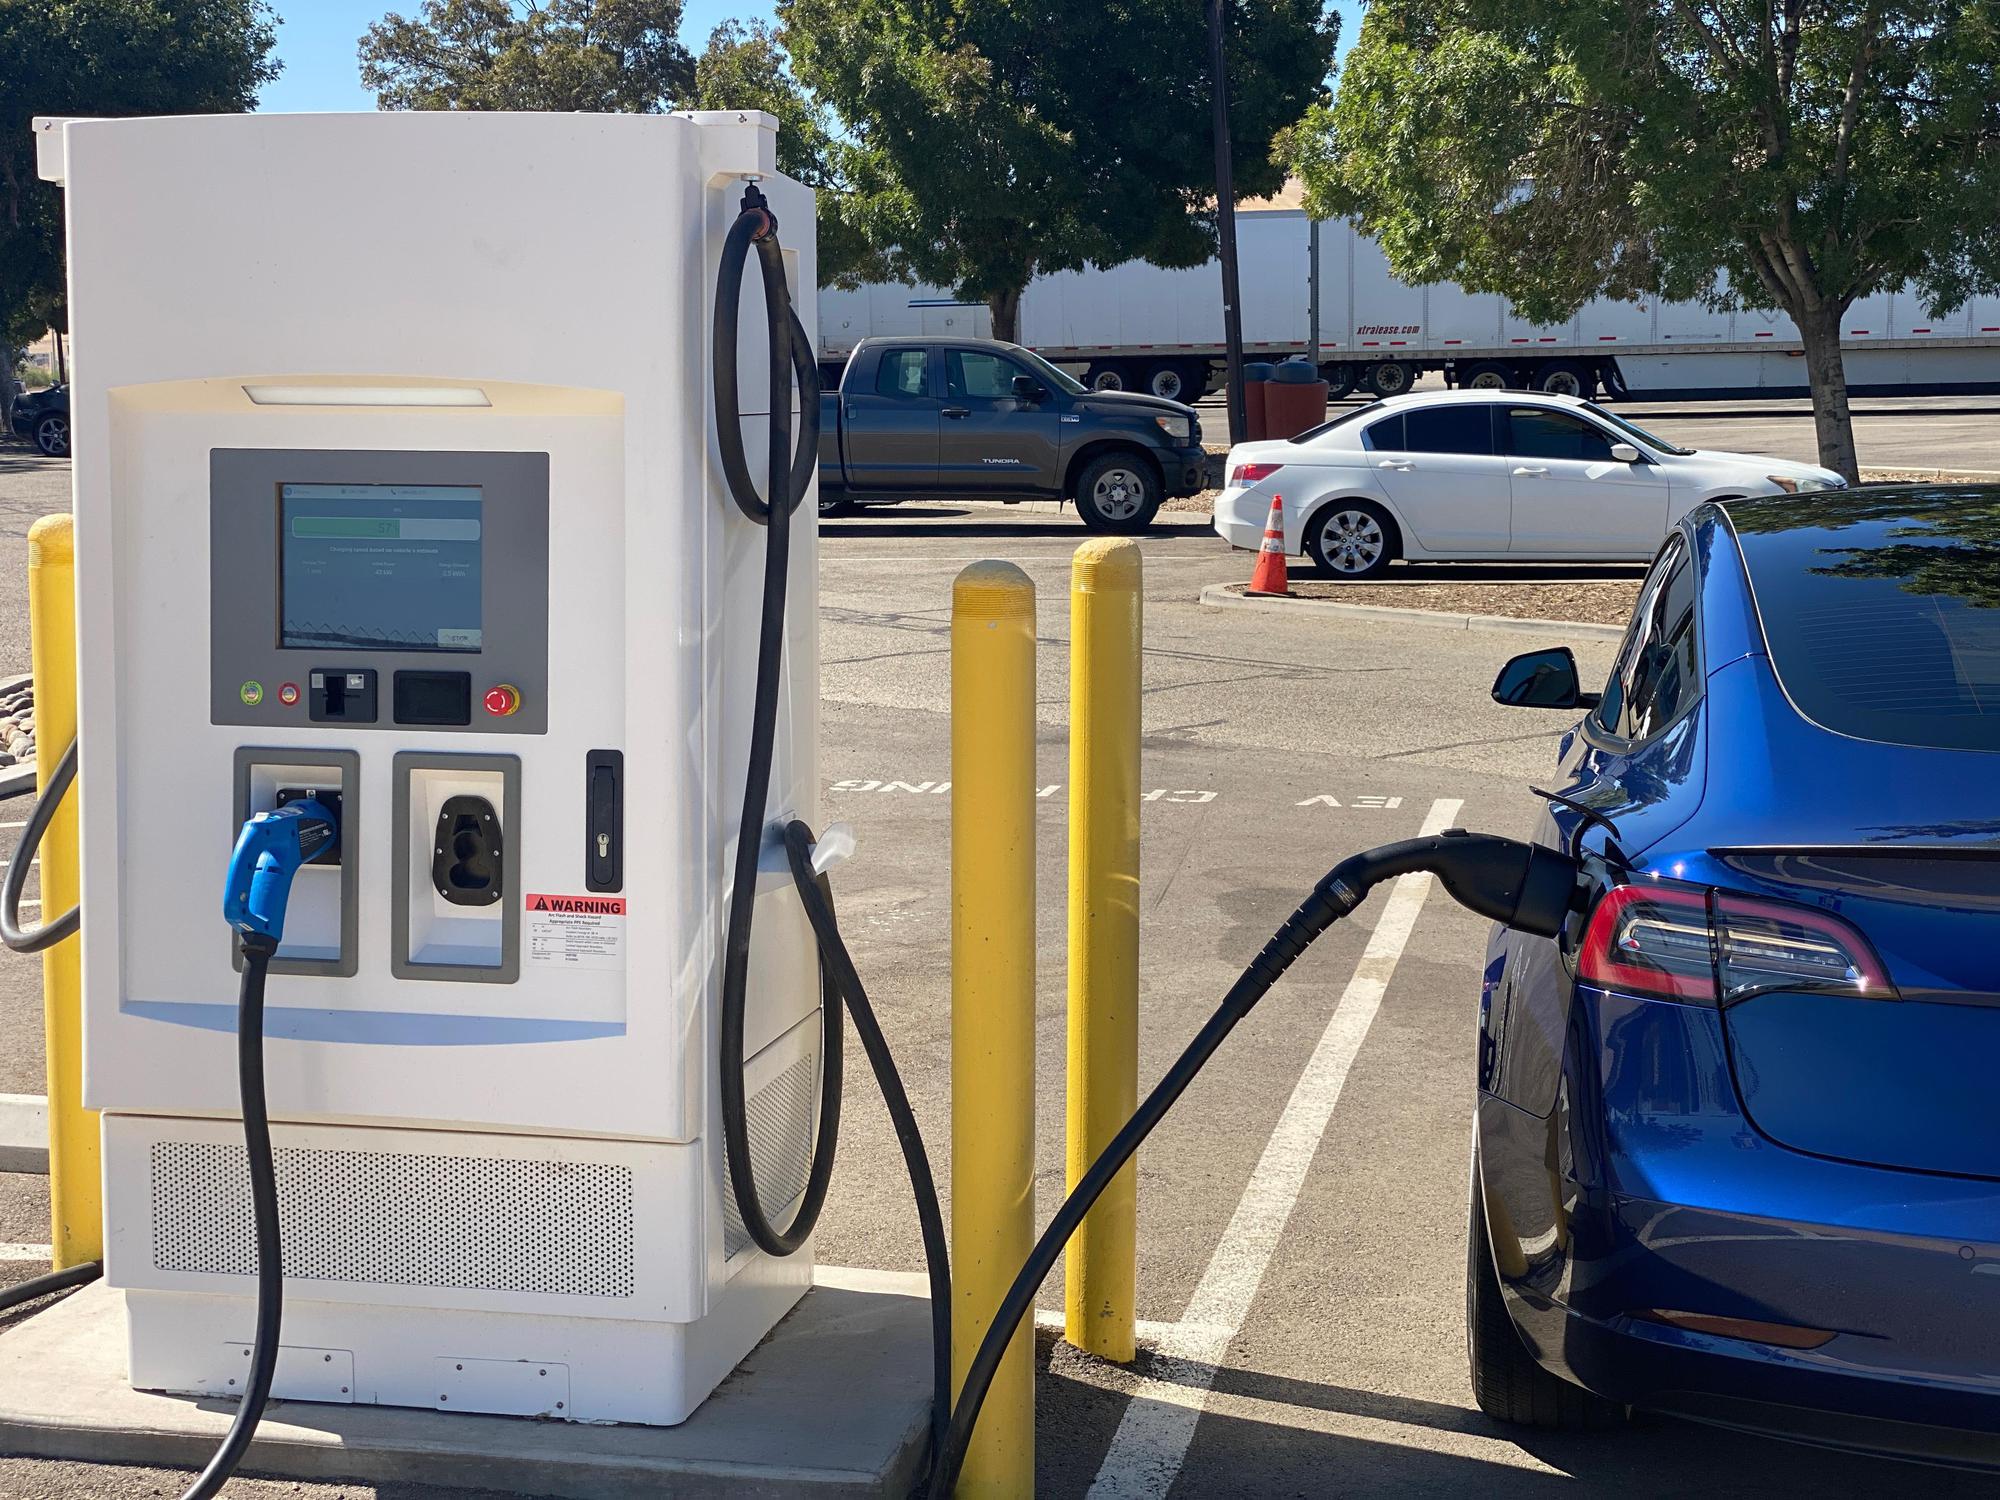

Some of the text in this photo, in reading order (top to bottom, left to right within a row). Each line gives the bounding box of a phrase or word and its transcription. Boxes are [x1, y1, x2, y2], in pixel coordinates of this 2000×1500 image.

[1357, 325, 1420, 335] xtralease.com
[828, 779, 1403, 808] EV CHING
[551, 899, 621, 914] WARNING
